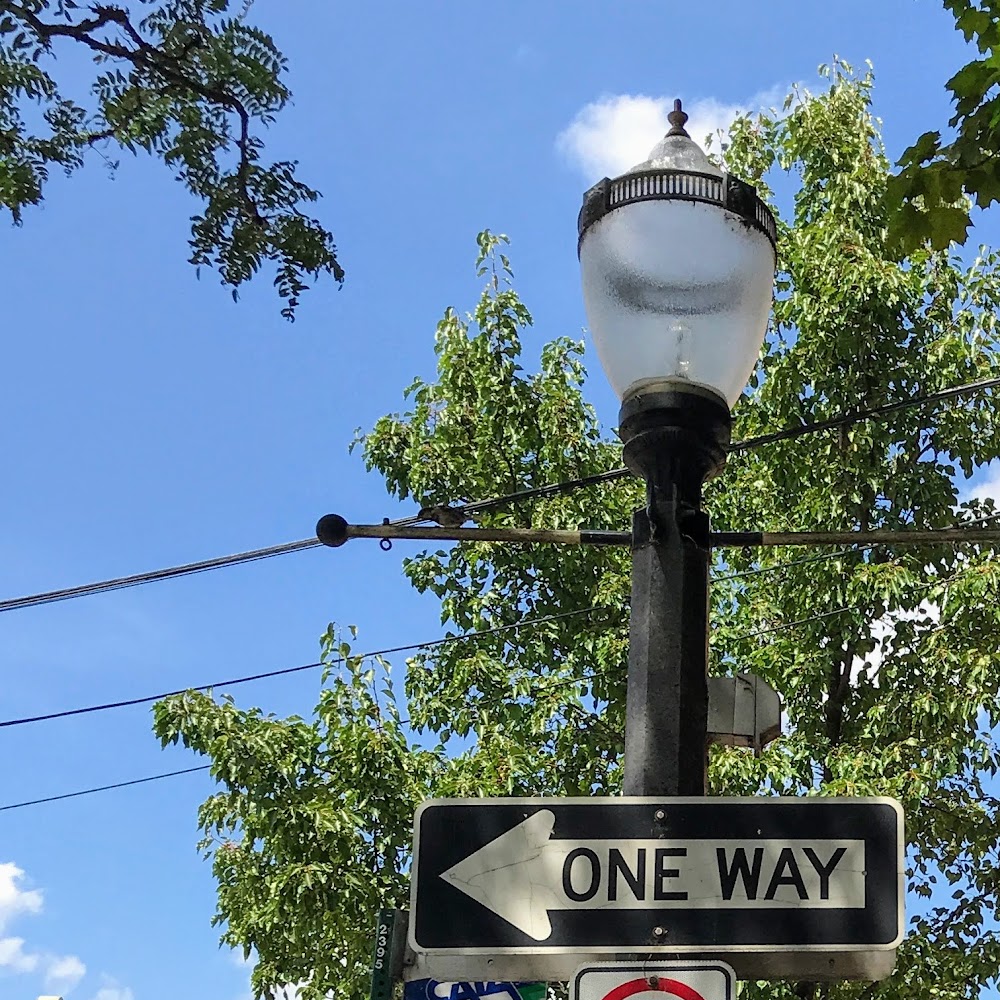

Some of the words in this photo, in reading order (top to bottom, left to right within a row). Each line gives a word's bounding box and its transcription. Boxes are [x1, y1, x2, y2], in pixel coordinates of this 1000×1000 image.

[562, 847, 688, 903] ONE
[716, 846, 848, 901] WAY
[374, 924, 388, 970] 2395
